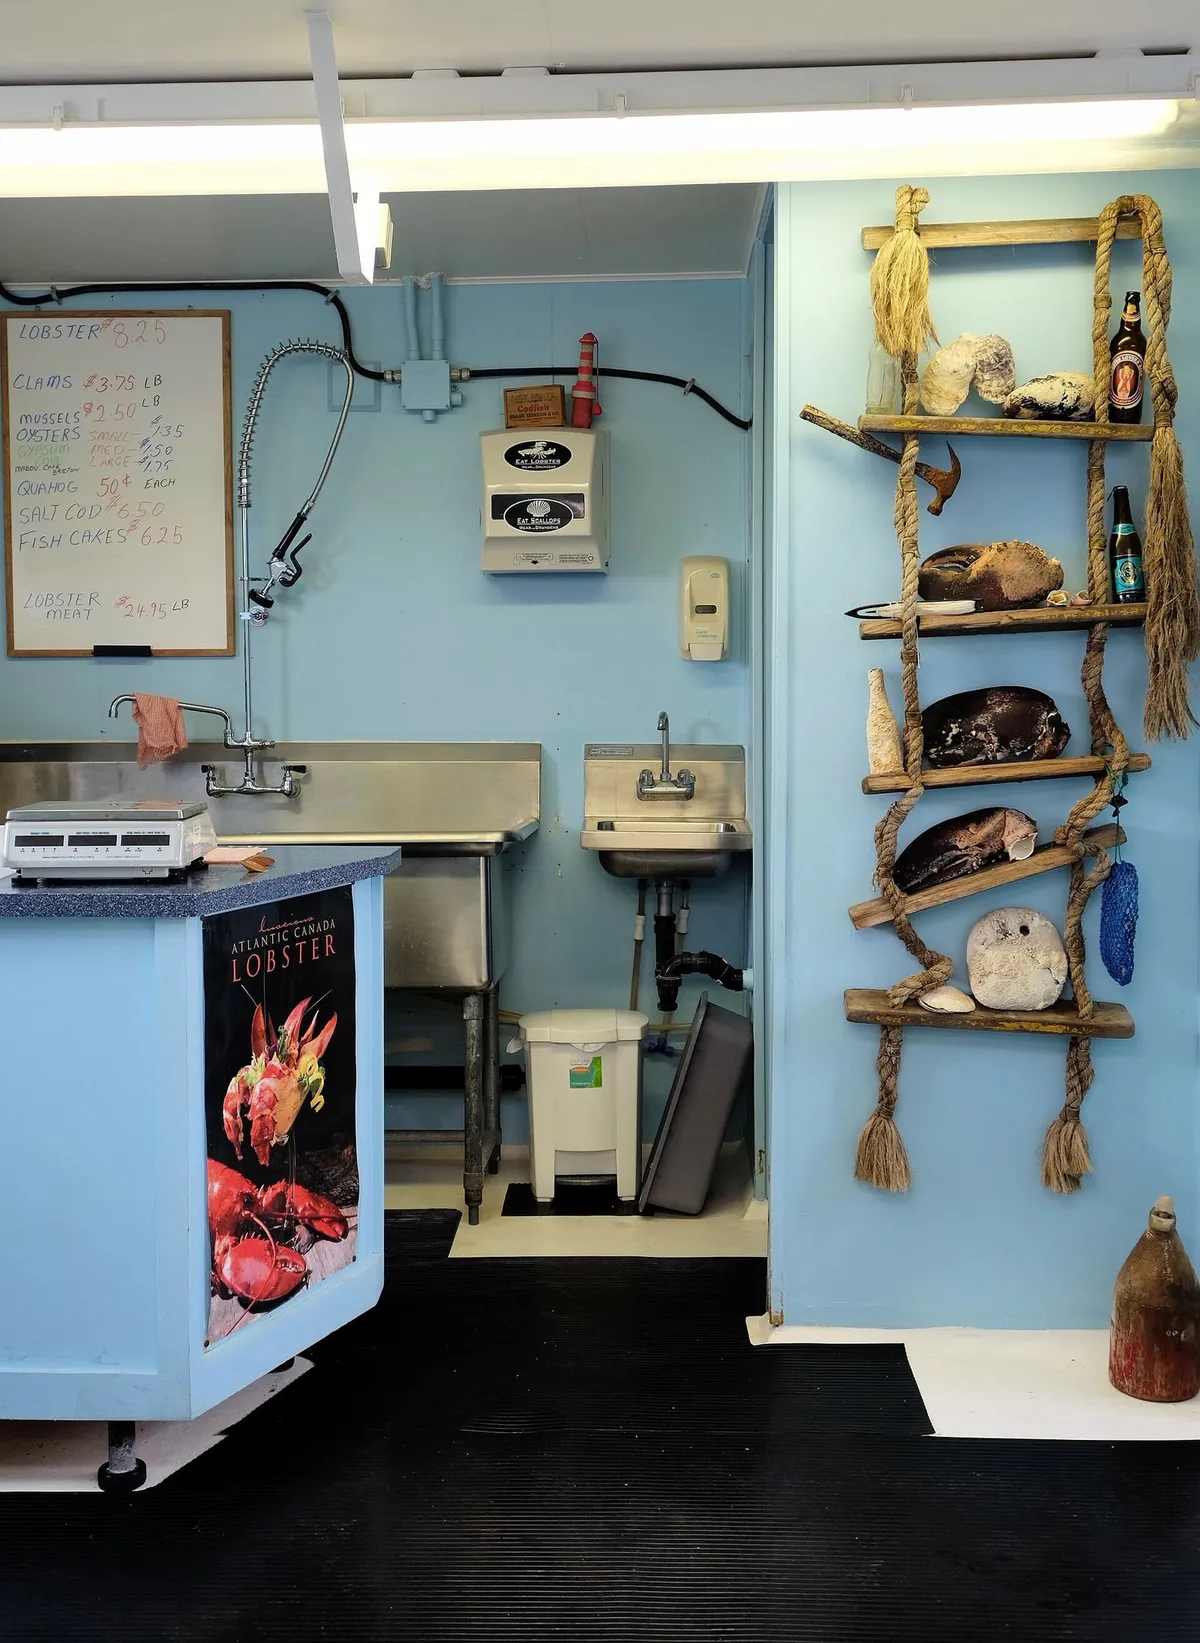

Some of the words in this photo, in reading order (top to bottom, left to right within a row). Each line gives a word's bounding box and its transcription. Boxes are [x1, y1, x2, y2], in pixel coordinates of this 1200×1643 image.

[19, 324, 100, 340] LOBSTER
[12, 373, 73, 390] CLAMS
[83, 372, 136, 393] $3.75
[144, 374, 163, 389] LB
[19, 411, 81, 425] MUSSELS
[83, 401, 137, 423] $2.50
[141, 394, 161, 408] LB
[517, 404, 550, 412] Codfish
[16, 426, 81, 443] OYSTERS
[88, 430, 131, 443] SMALL
[90, 444, 125, 456] MED
[89, 455, 132, 468] LARGE
[16, 480, 78, 496] QUAHOG
[96, 474, 132, 497] 50¢
[144, 478, 176, 489] EACH
[19, 504, 60, 524] SALT
[64, 503, 102, 521] COD
[19, 531, 62, 552] FISH
[69, 528, 127, 546] CAKES
[24, 592, 101, 608] LOBSTER
[114, 596, 167, 619] $24.95
[172, 599, 190, 611] LB
[46, 609, 94, 621] MEAT
[231, 929, 289, 955] ATLANTIC
[294, 919, 336, 938] CANADA
[232, 934, 336, 983] LOBSTER
